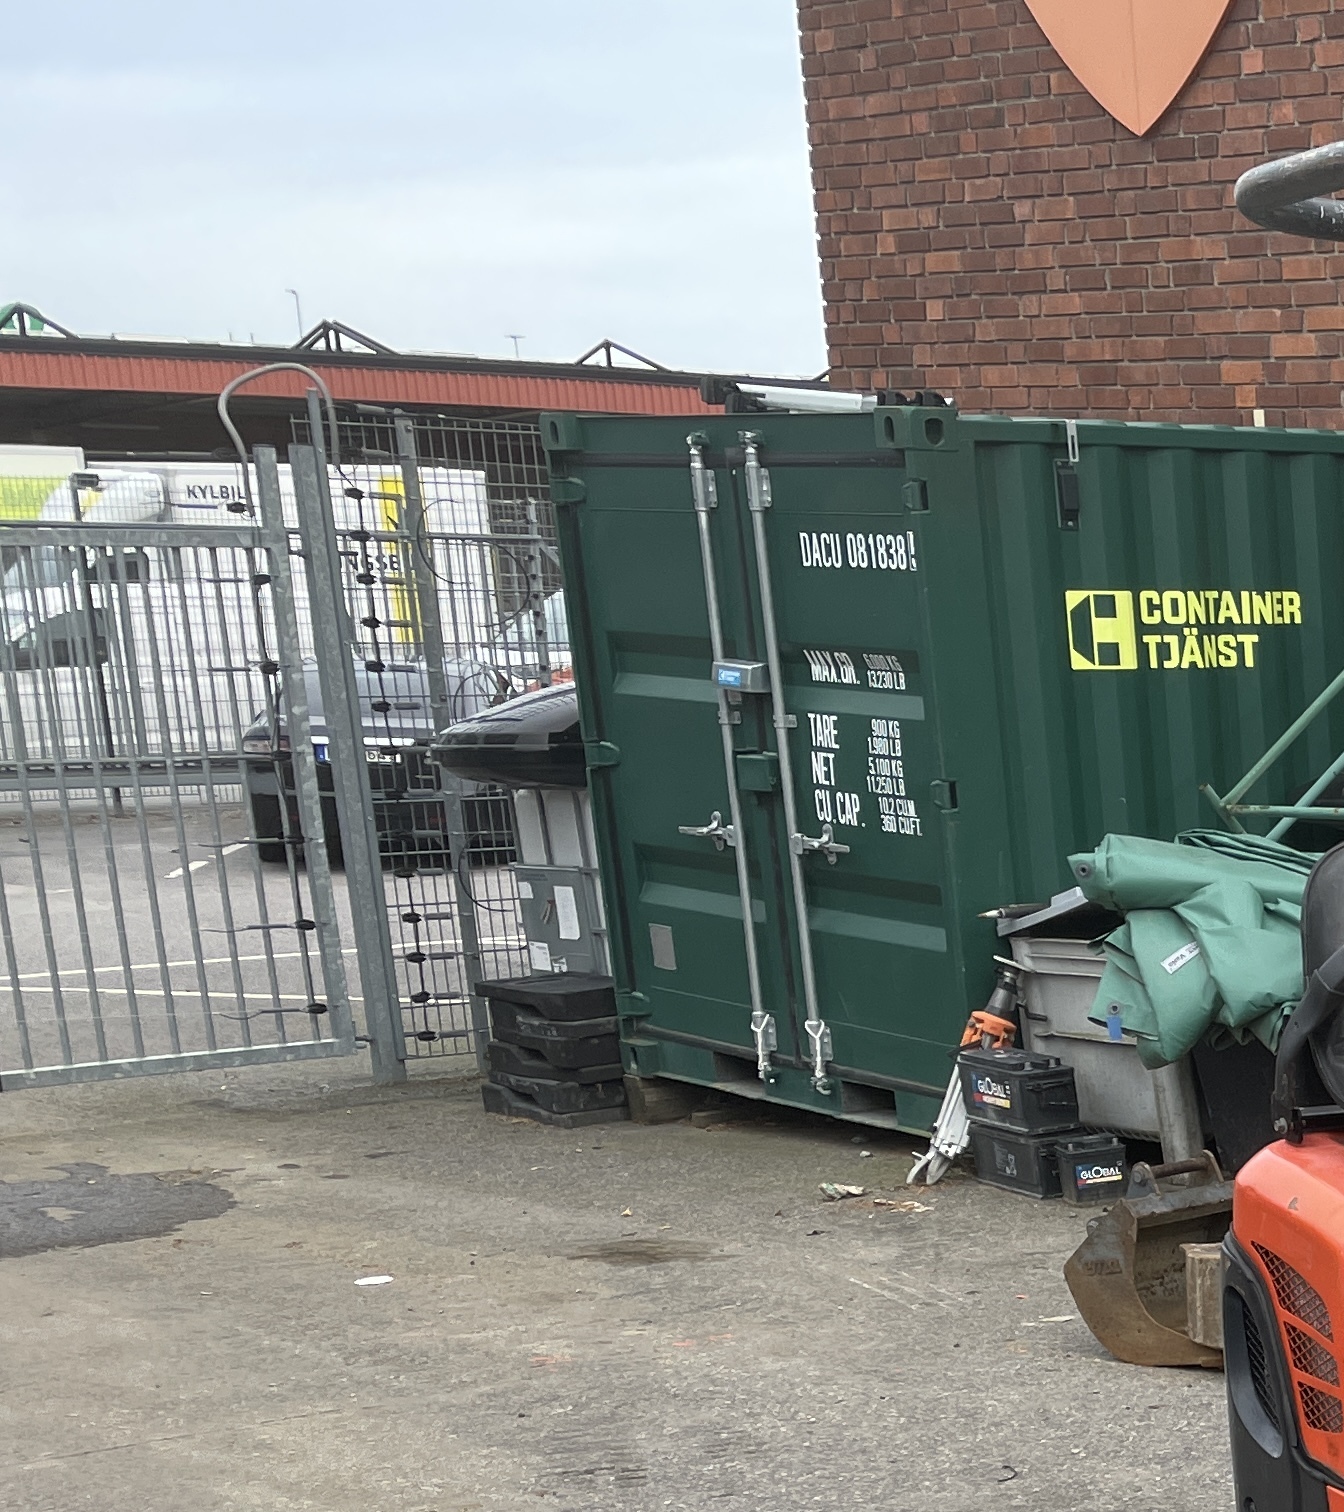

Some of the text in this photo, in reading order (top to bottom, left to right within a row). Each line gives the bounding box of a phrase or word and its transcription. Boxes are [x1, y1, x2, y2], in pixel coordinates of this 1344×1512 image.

[799, 532, 842, 568] DACU
[1139, 590, 1302, 625] CONTAINER
[1143, 627, 1259, 669] TJÄNST
[885, 655, 902, 671] KG
[893, 671, 906, 690] LB
[807, 713, 900, 749] TARE 900 KG
[889, 738, 902, 757] LB
[811, 751, 835, 786] NET
[891, 759, 904, 777] KG
[893, 777, 906, 796] LB
[880, 815, 897, 833] 360
[1080, 1166, 1121, 1180] GLOBAL
